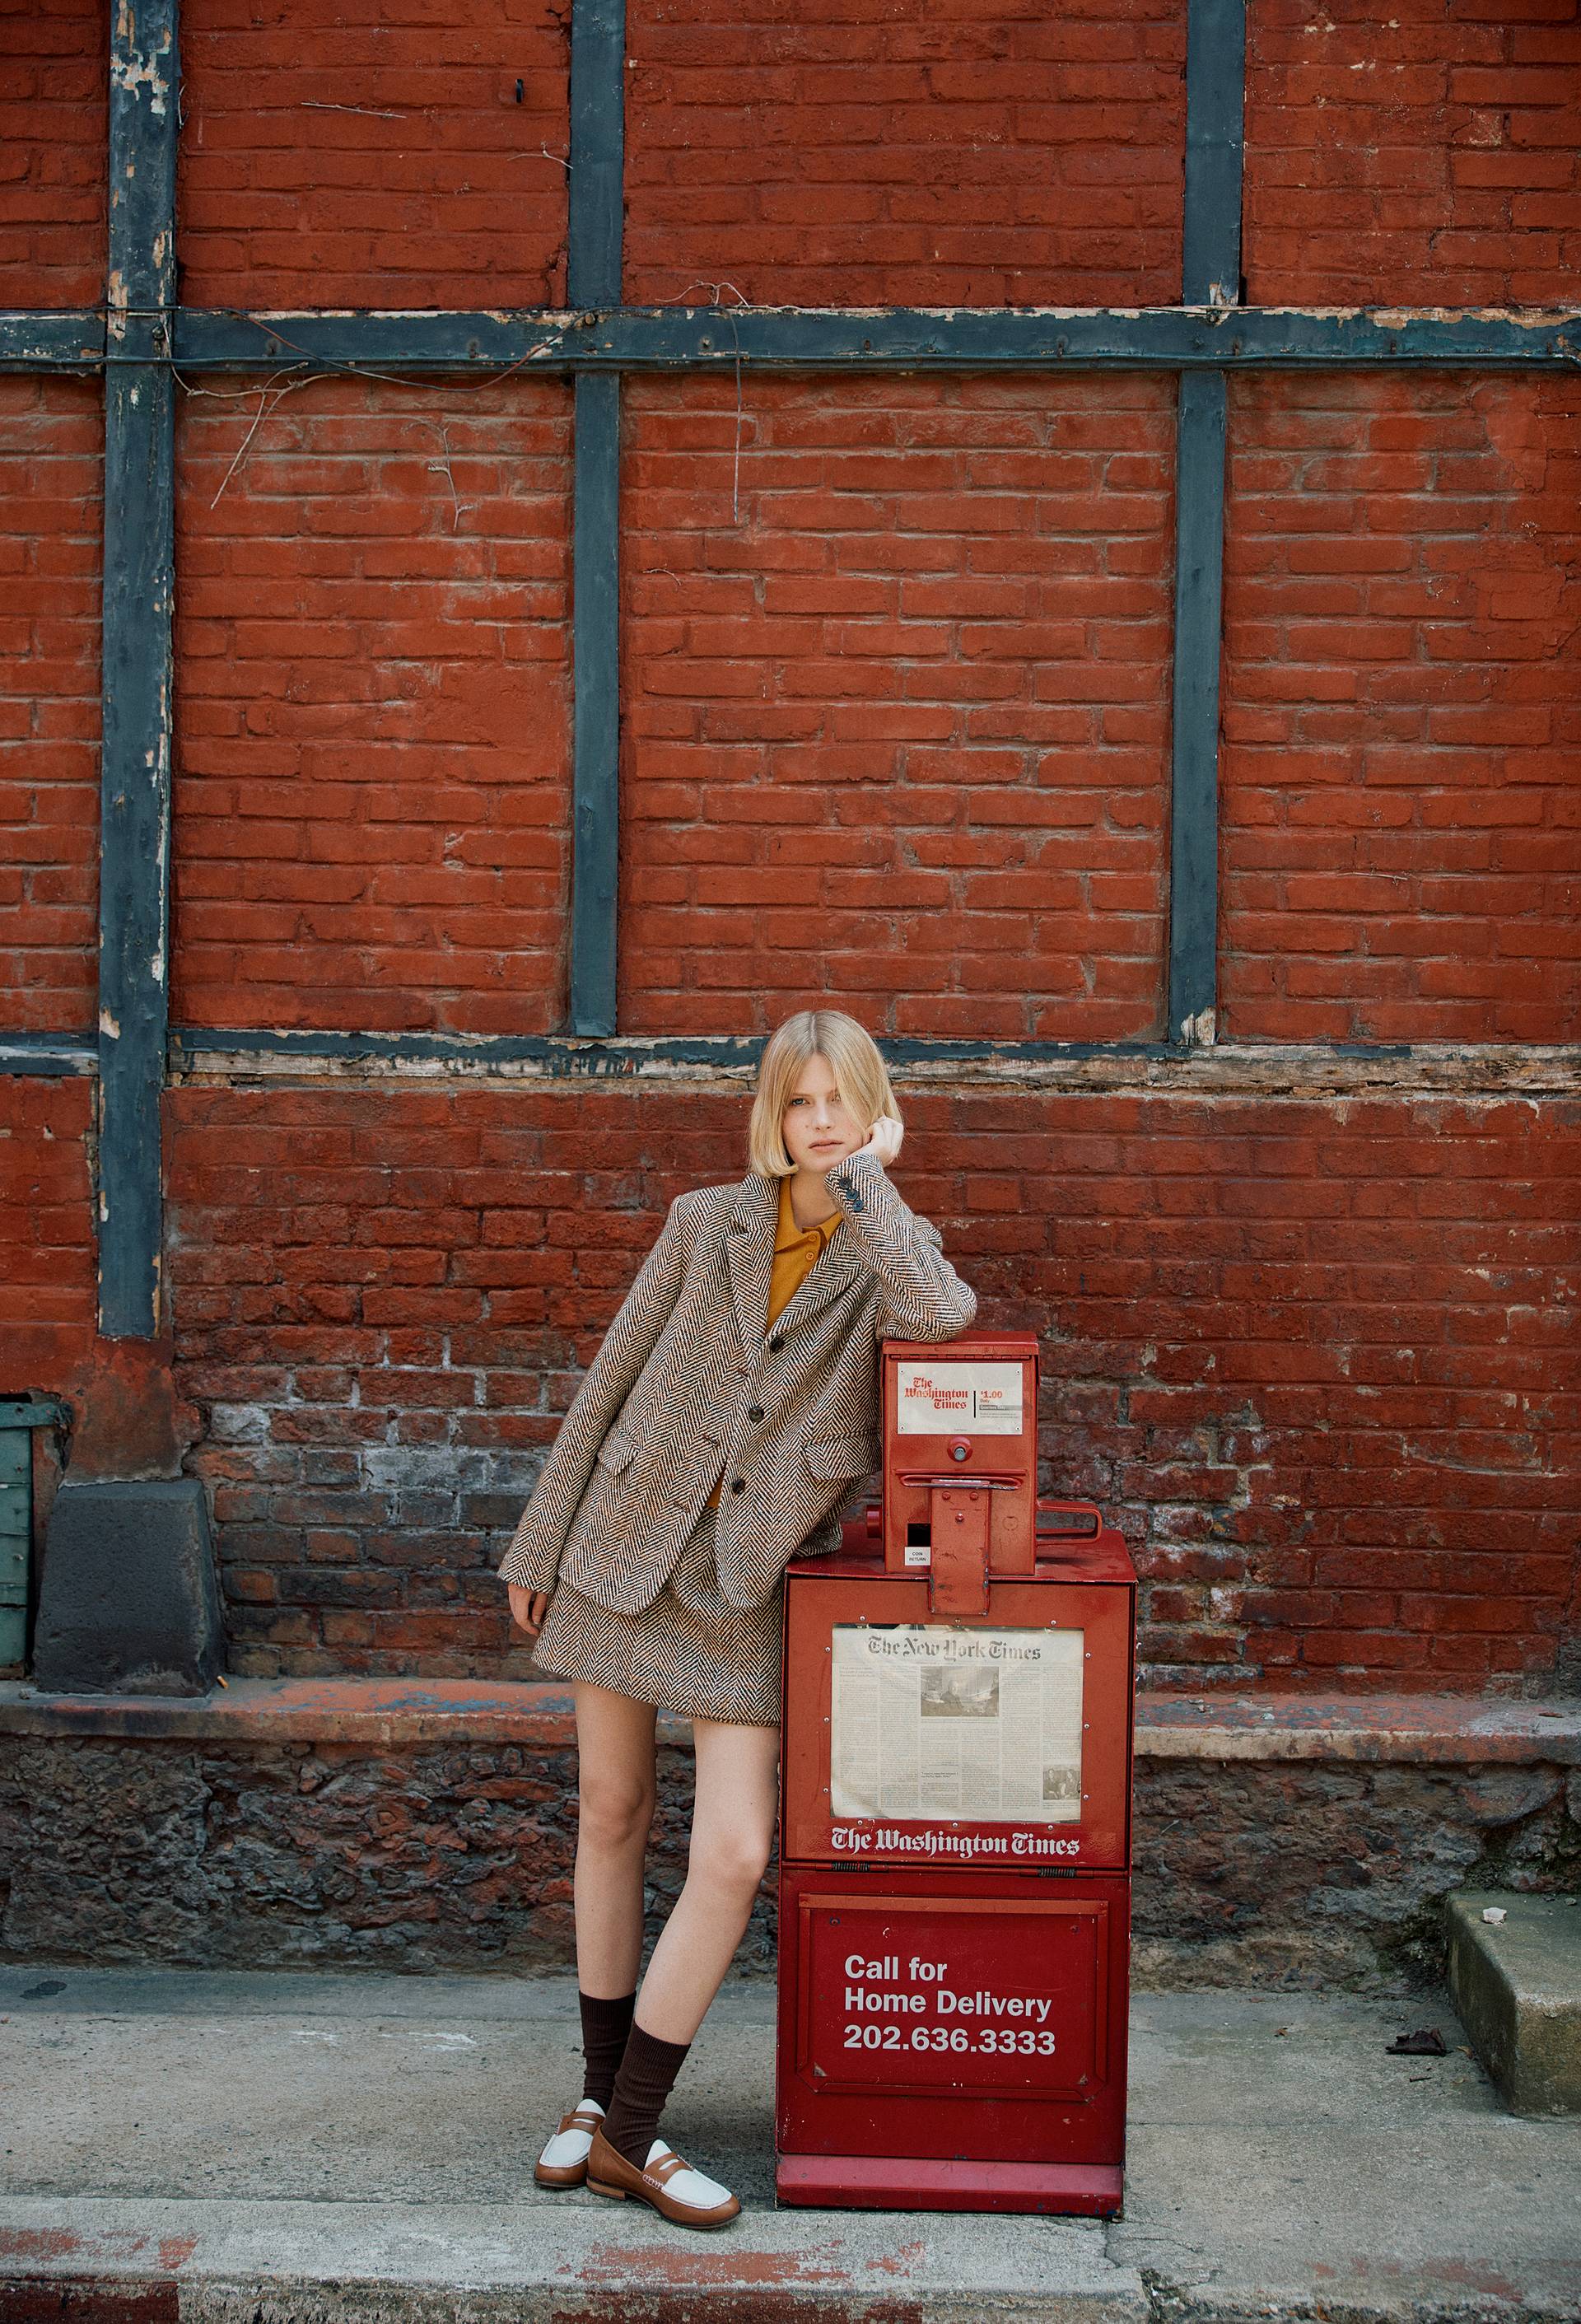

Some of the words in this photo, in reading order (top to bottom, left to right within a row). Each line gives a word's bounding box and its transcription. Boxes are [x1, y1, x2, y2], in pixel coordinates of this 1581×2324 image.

[904, 1387, 968, 1401] Washington
[913, 1377, 933, 1388] The
[933, 1398, 967, 1409] Times
[868, 1636, 900, 1655] The
[902, 1637, 940, 1657] New
[943, 1639, 986, 1662] York
[988, 1640, 1041, 1660] Times
[831, 1827, 871, 1854] The
[875, 1828, 1008, 1859] Washington
[1010, 1832, 1080, 1855] Times
[845, 1954, 898, 1980] Call
[908, 1957, 948, 1981] for
[845, 1987, 926, 2013] Home
[937, 1990, 1052, 2022] Delivery
[843, 2024, 1056, 2055] 202.636.3333
